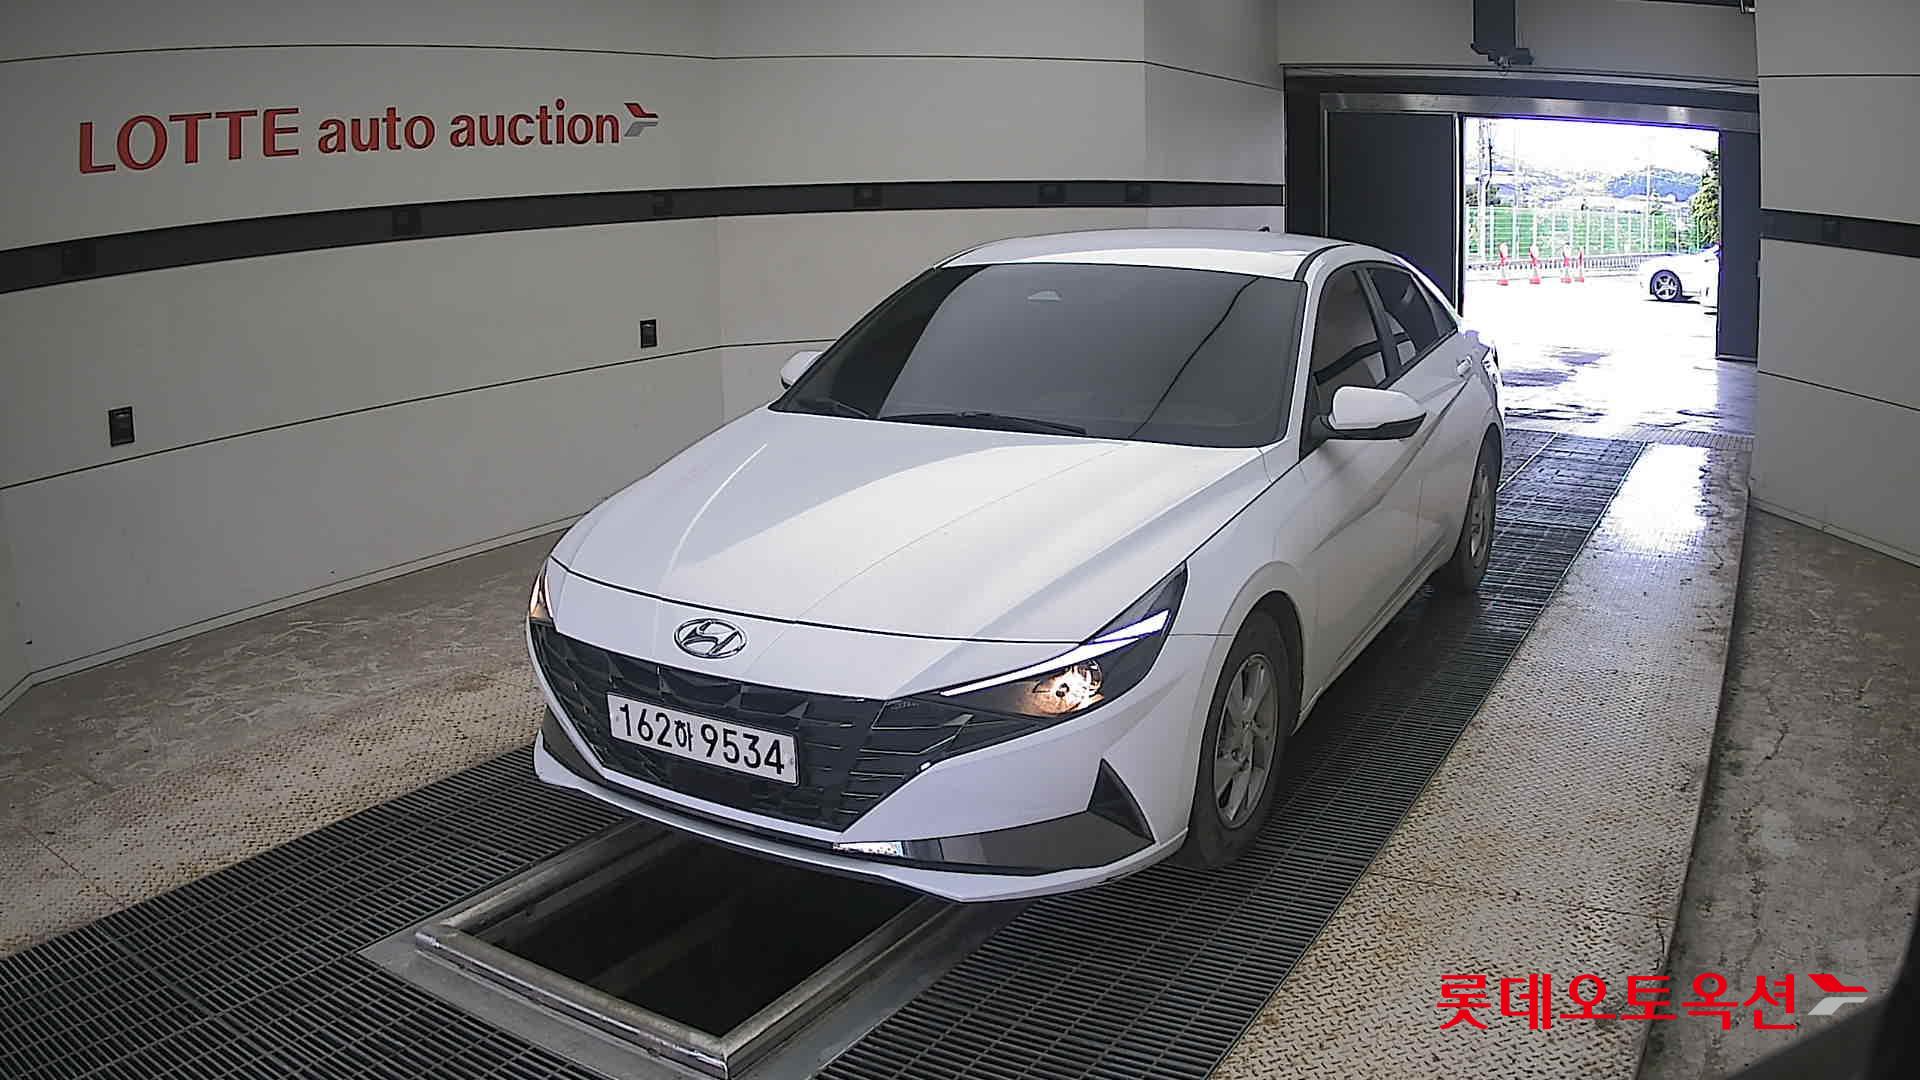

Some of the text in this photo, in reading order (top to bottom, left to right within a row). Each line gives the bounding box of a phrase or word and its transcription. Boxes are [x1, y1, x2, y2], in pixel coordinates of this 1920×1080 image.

[79, 98, 619, 174] LOTTE auto auction
[701, 723, 785, 775] 9534
